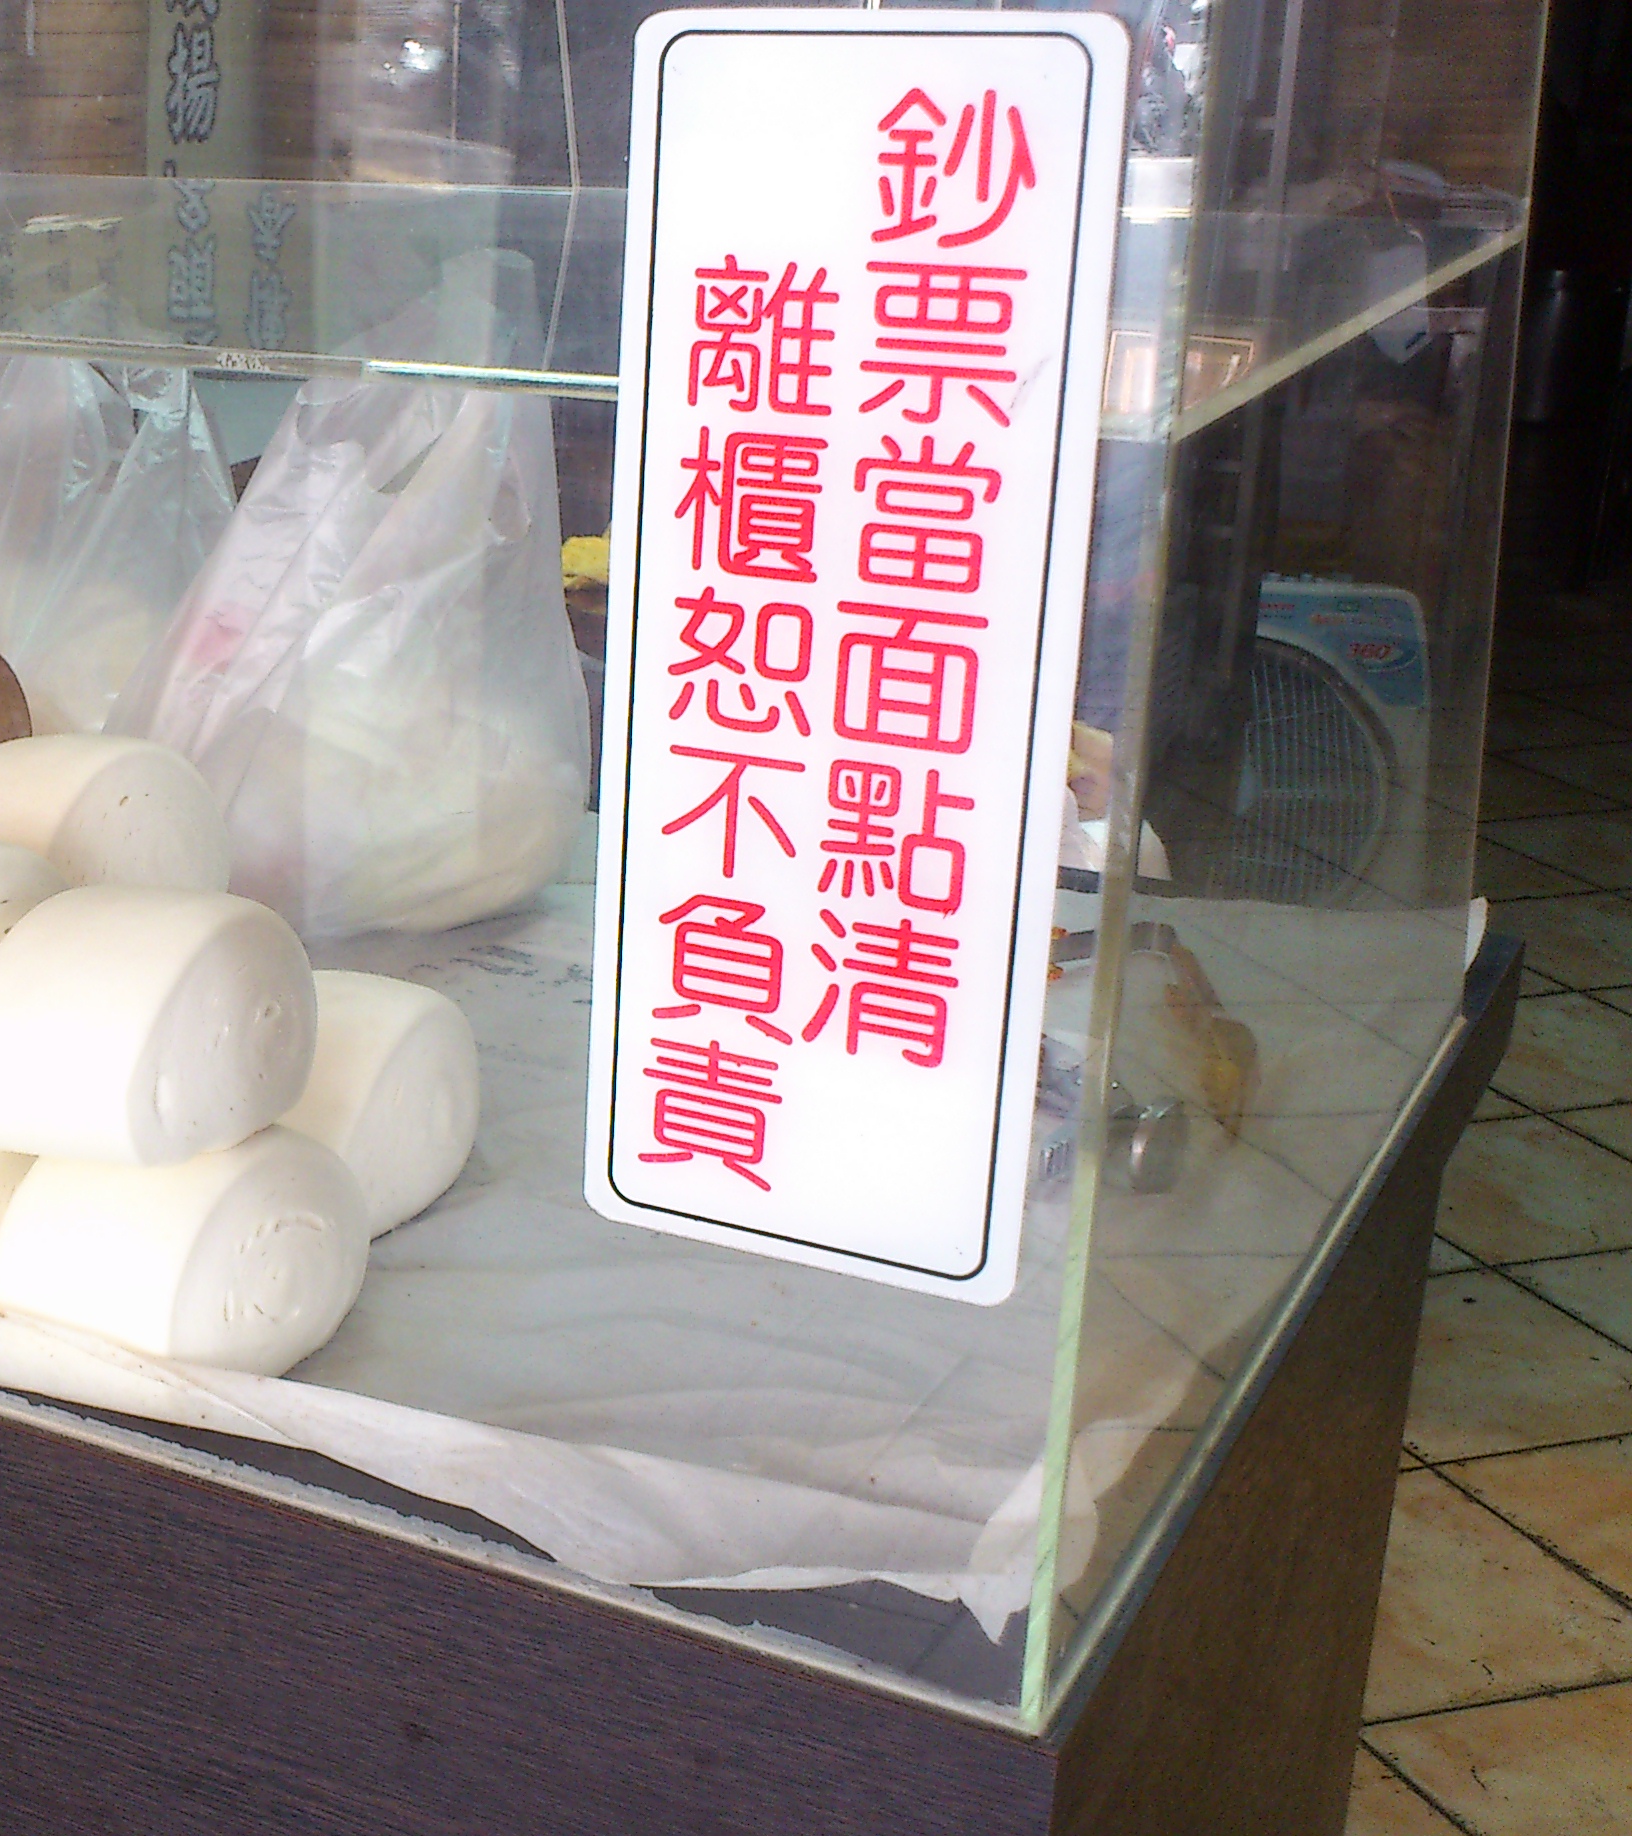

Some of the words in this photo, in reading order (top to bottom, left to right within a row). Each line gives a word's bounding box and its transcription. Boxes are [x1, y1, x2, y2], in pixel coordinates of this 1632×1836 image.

[639, 253, 840, 1192] 離櫃恕不負責
[802, 87, 1037, 1069] 鈔票當面點清
